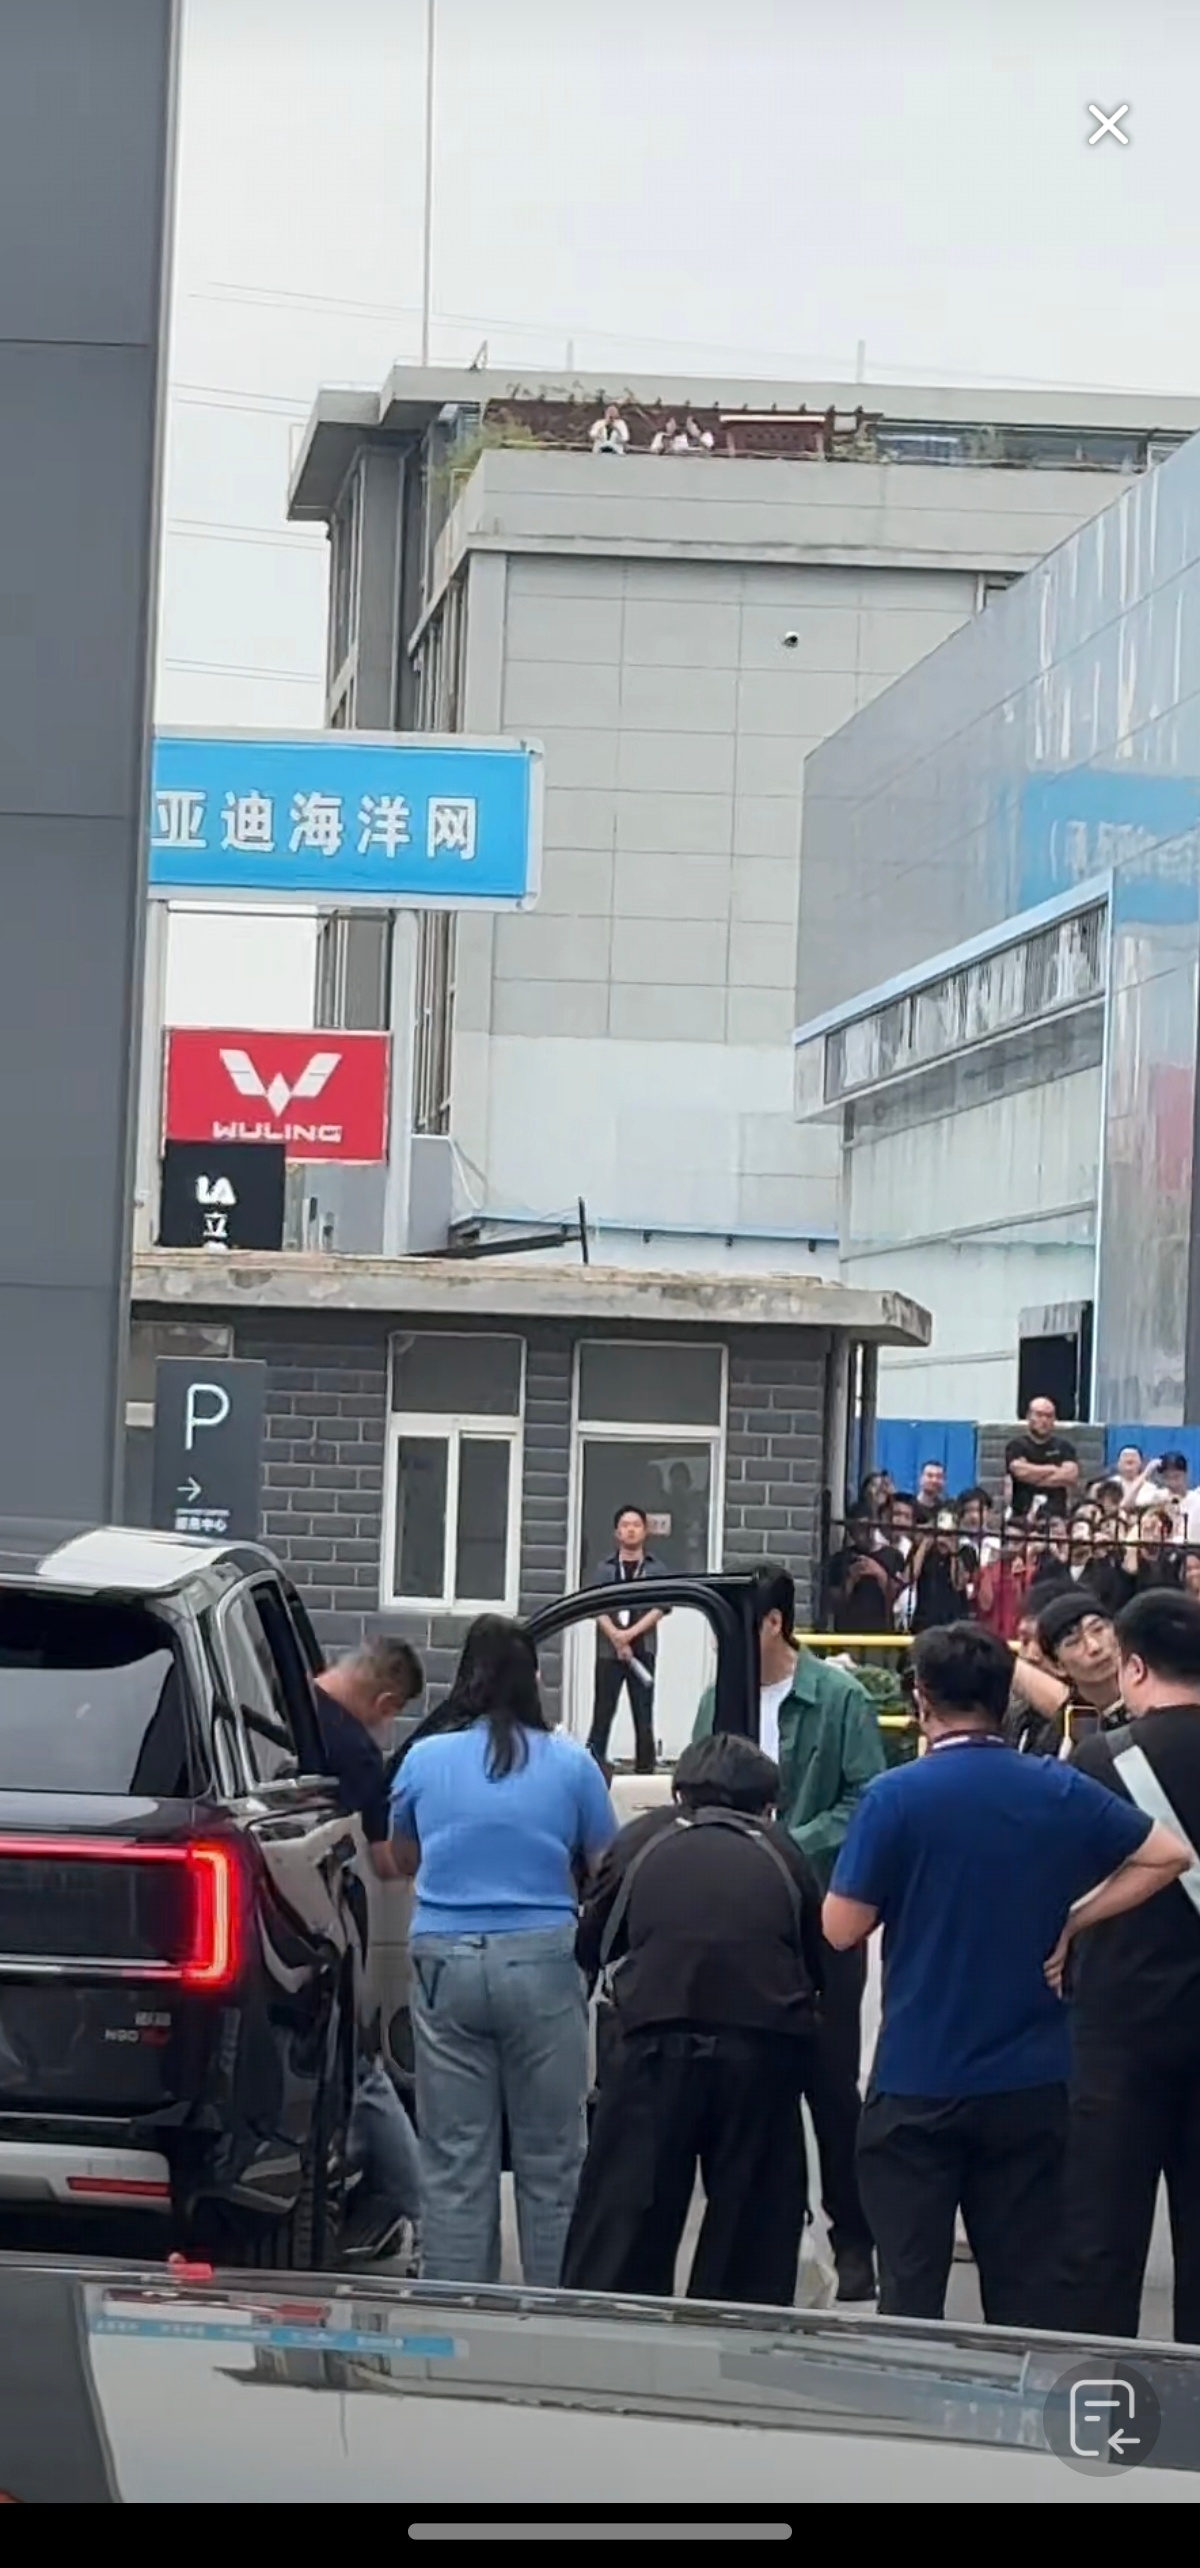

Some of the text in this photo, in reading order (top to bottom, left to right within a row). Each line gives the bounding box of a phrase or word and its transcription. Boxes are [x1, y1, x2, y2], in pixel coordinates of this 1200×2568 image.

[151, 789, 477, 860] 亚迪海洋网
[212, 1121, 342, 1143] WULING
[202, 1211, 229, 1250] 立
[185, 1383, 230, 1450] P
